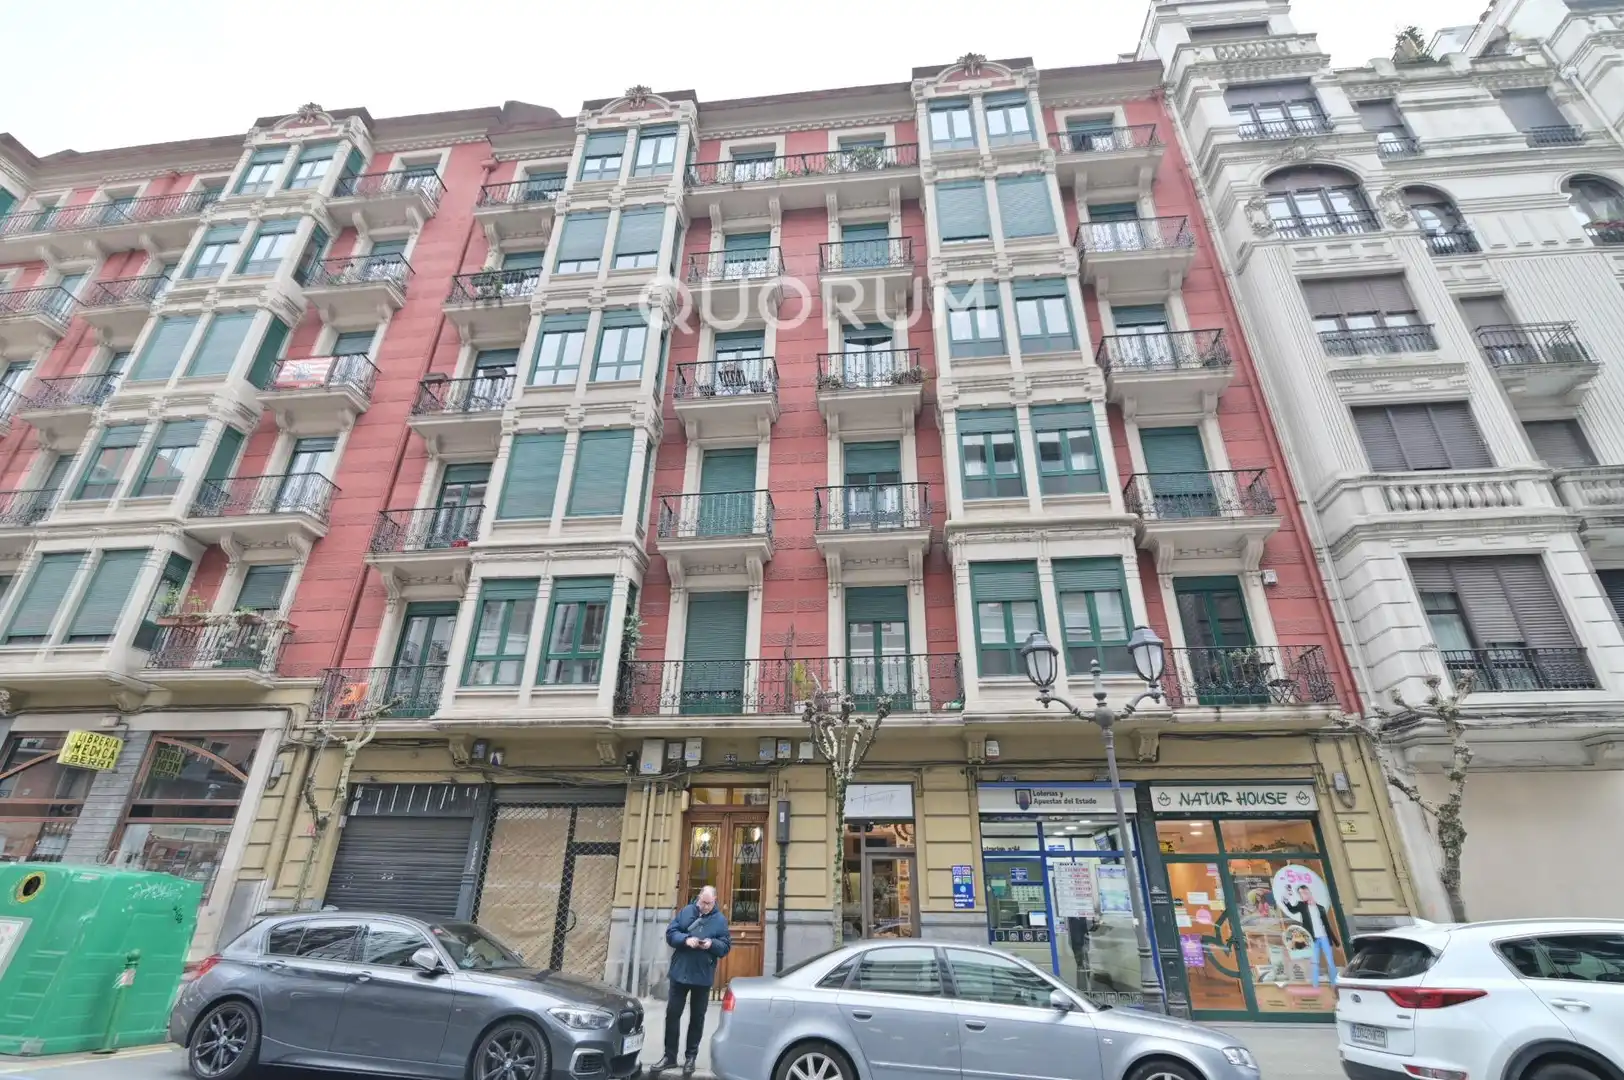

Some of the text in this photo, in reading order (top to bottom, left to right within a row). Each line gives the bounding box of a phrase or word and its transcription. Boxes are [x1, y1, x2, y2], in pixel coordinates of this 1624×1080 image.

[78, 733, 119, 749] LIBRERIA
[69, 754, 112, 769] BERRI
[1033, 797, 1097, 806] Apuestas del Estado
[1179, 790, 1288, 806] NATUR HOUSE
